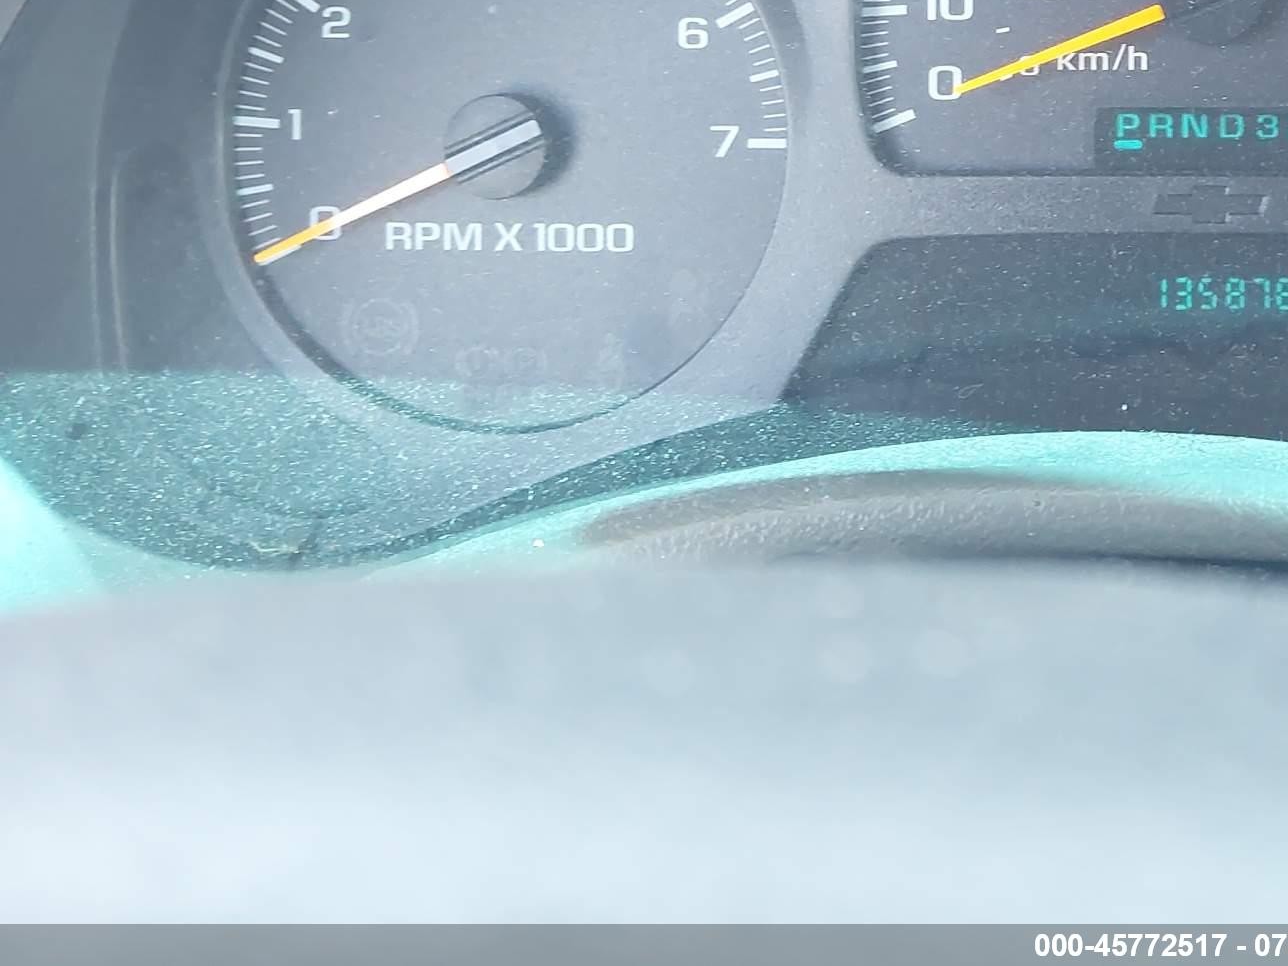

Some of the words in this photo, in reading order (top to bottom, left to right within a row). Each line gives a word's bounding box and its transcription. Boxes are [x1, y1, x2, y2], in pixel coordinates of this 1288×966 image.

[321, 6, 351, 38] 2
[677, 17, 709, 49] 6
[1057, 44, 1149, 72] km/h
[928, 65, 963, 100] 0
[290, 109, 302, 139] 1
[710, 126, 740, 157] 7
[309, 206, 341, 241] 0
[385, 222, 481, 251] RPM
[494, 222, 523, 251] X
[535, 222, 634, 252] 1000
